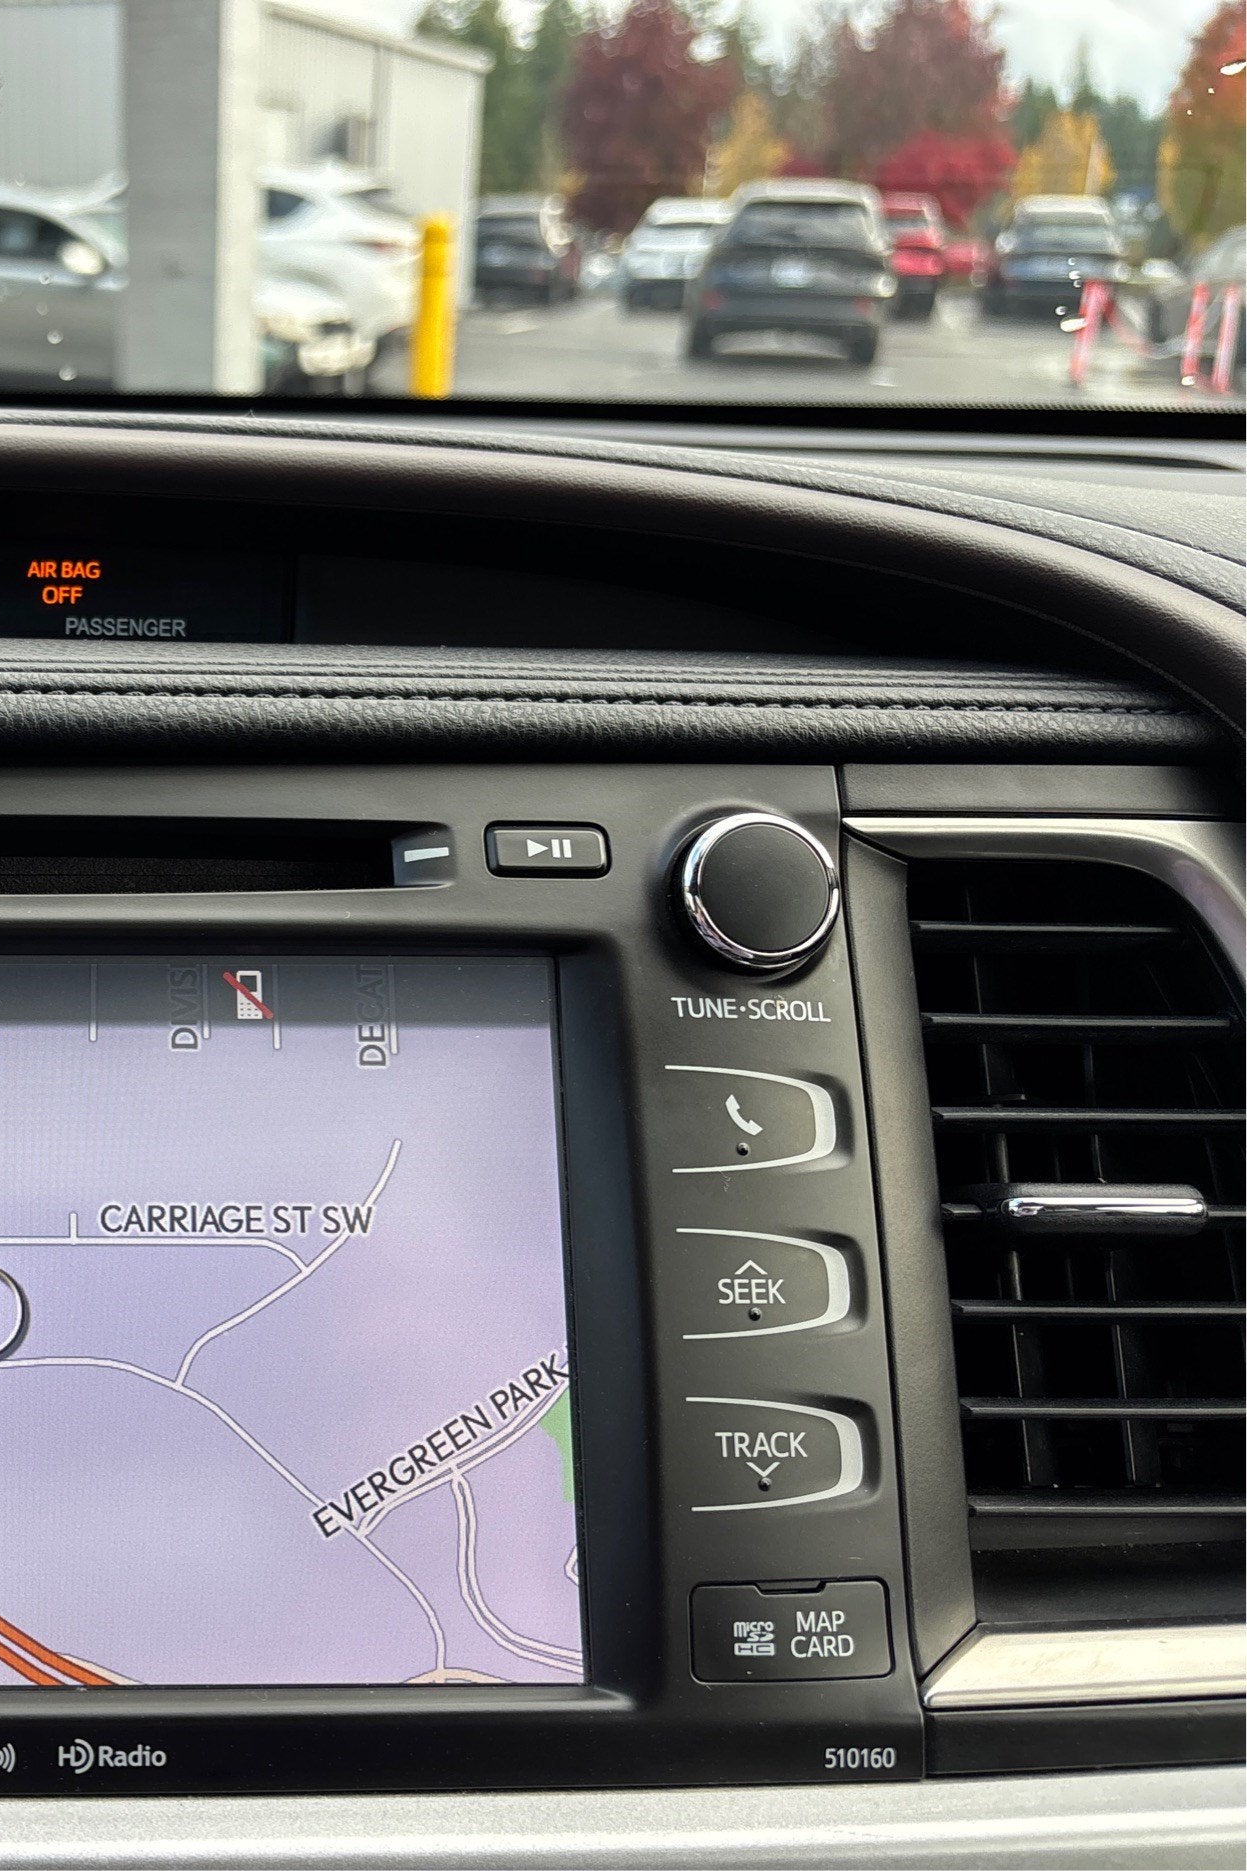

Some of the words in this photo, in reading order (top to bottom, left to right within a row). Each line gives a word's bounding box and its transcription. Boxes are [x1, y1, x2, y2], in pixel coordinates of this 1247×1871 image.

[27, 561, 57, 578] AIR
[61, 561, 101, 579] BAG
[42, 586, 83, 605] OFF
[64, 617, 186, 637] PASSENGER
[100, 1205, 264, 1234] CARRIAGE
[273, 1206, 313, 1233] ST
[323, 1206, 374, 1234] SW
[717, 1278, 786, 1305] SEEK
[312, 1404, 492, 1538] EVERGREEN
[489, 1352, 570, 1420] PARK
[714, 1431, 808, 1458] TRACK
[733, 1621, 775, 1638] micro
[796, 1610, 846, 1633] MAP
[790, 1634, 856, 1659] CARD
[98, 1744, 167, 1768] Radio
[824, 1747, 897, 1770] 510160
